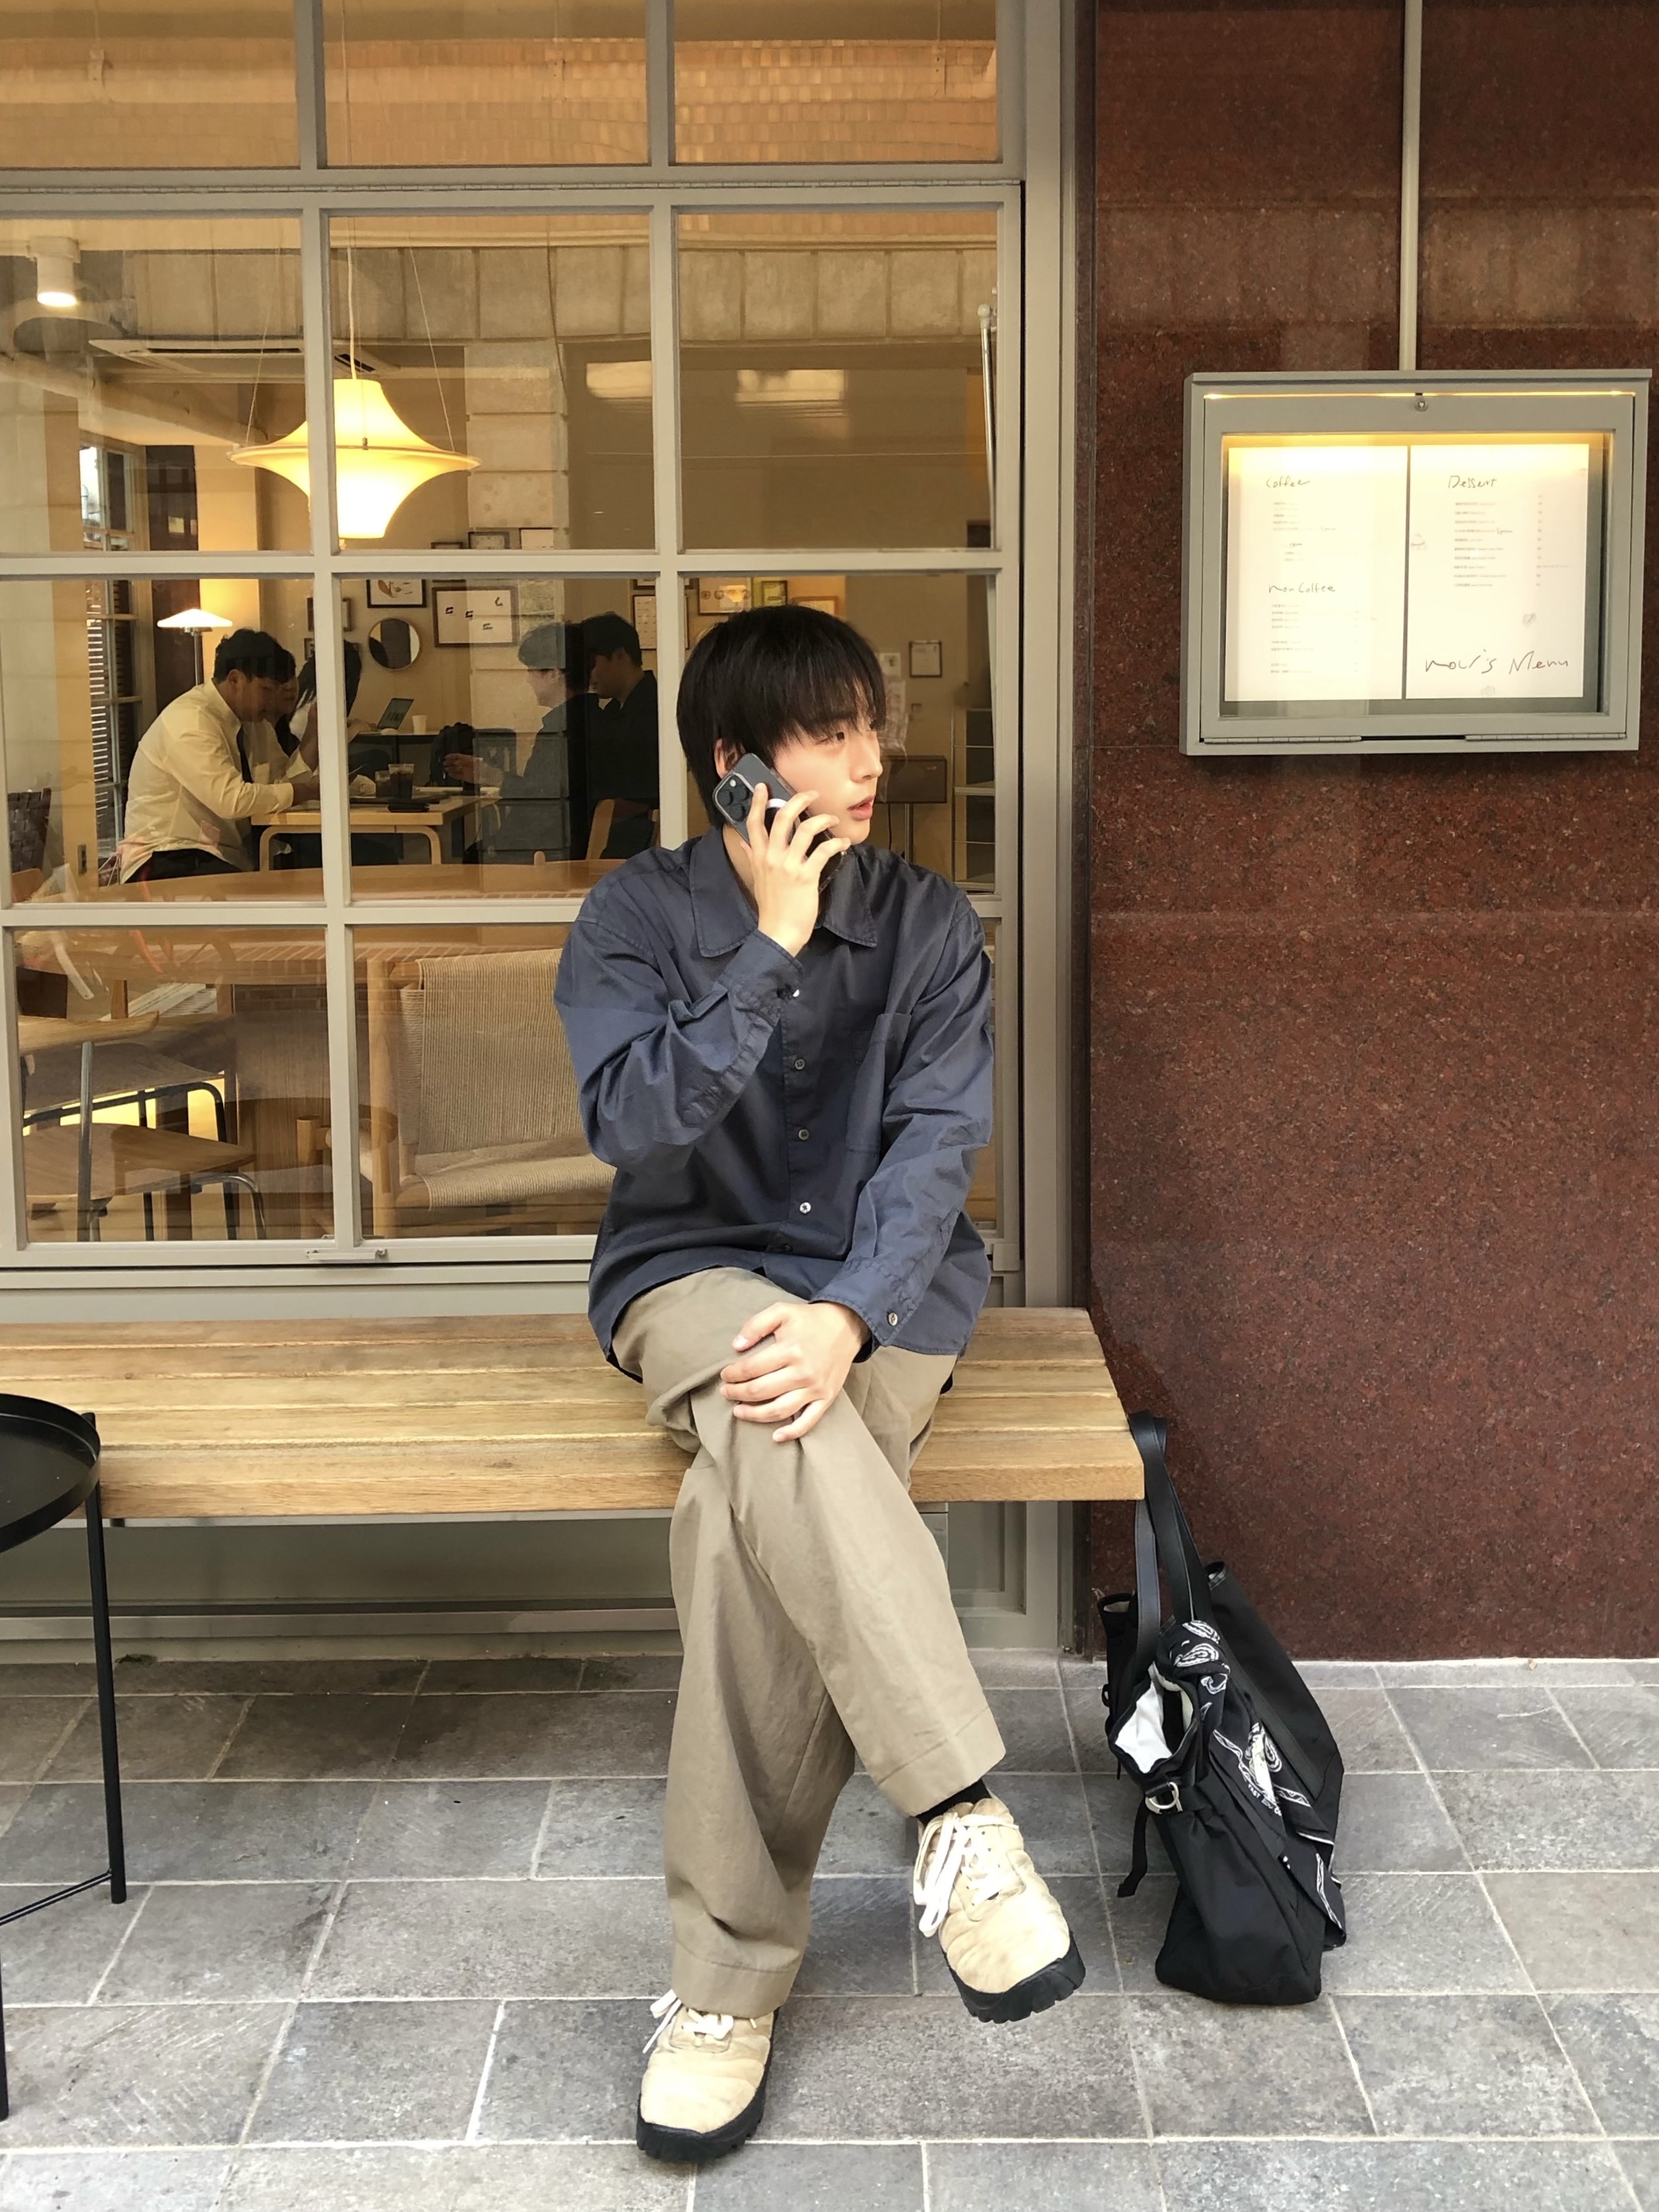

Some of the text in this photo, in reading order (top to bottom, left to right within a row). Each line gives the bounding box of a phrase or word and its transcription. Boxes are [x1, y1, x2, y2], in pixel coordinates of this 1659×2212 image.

[1266, 475, 1311, 488] Coffee
[1448, 475, 1497, 489] Dessert
[1508, 650, 1569, 675] Menu
